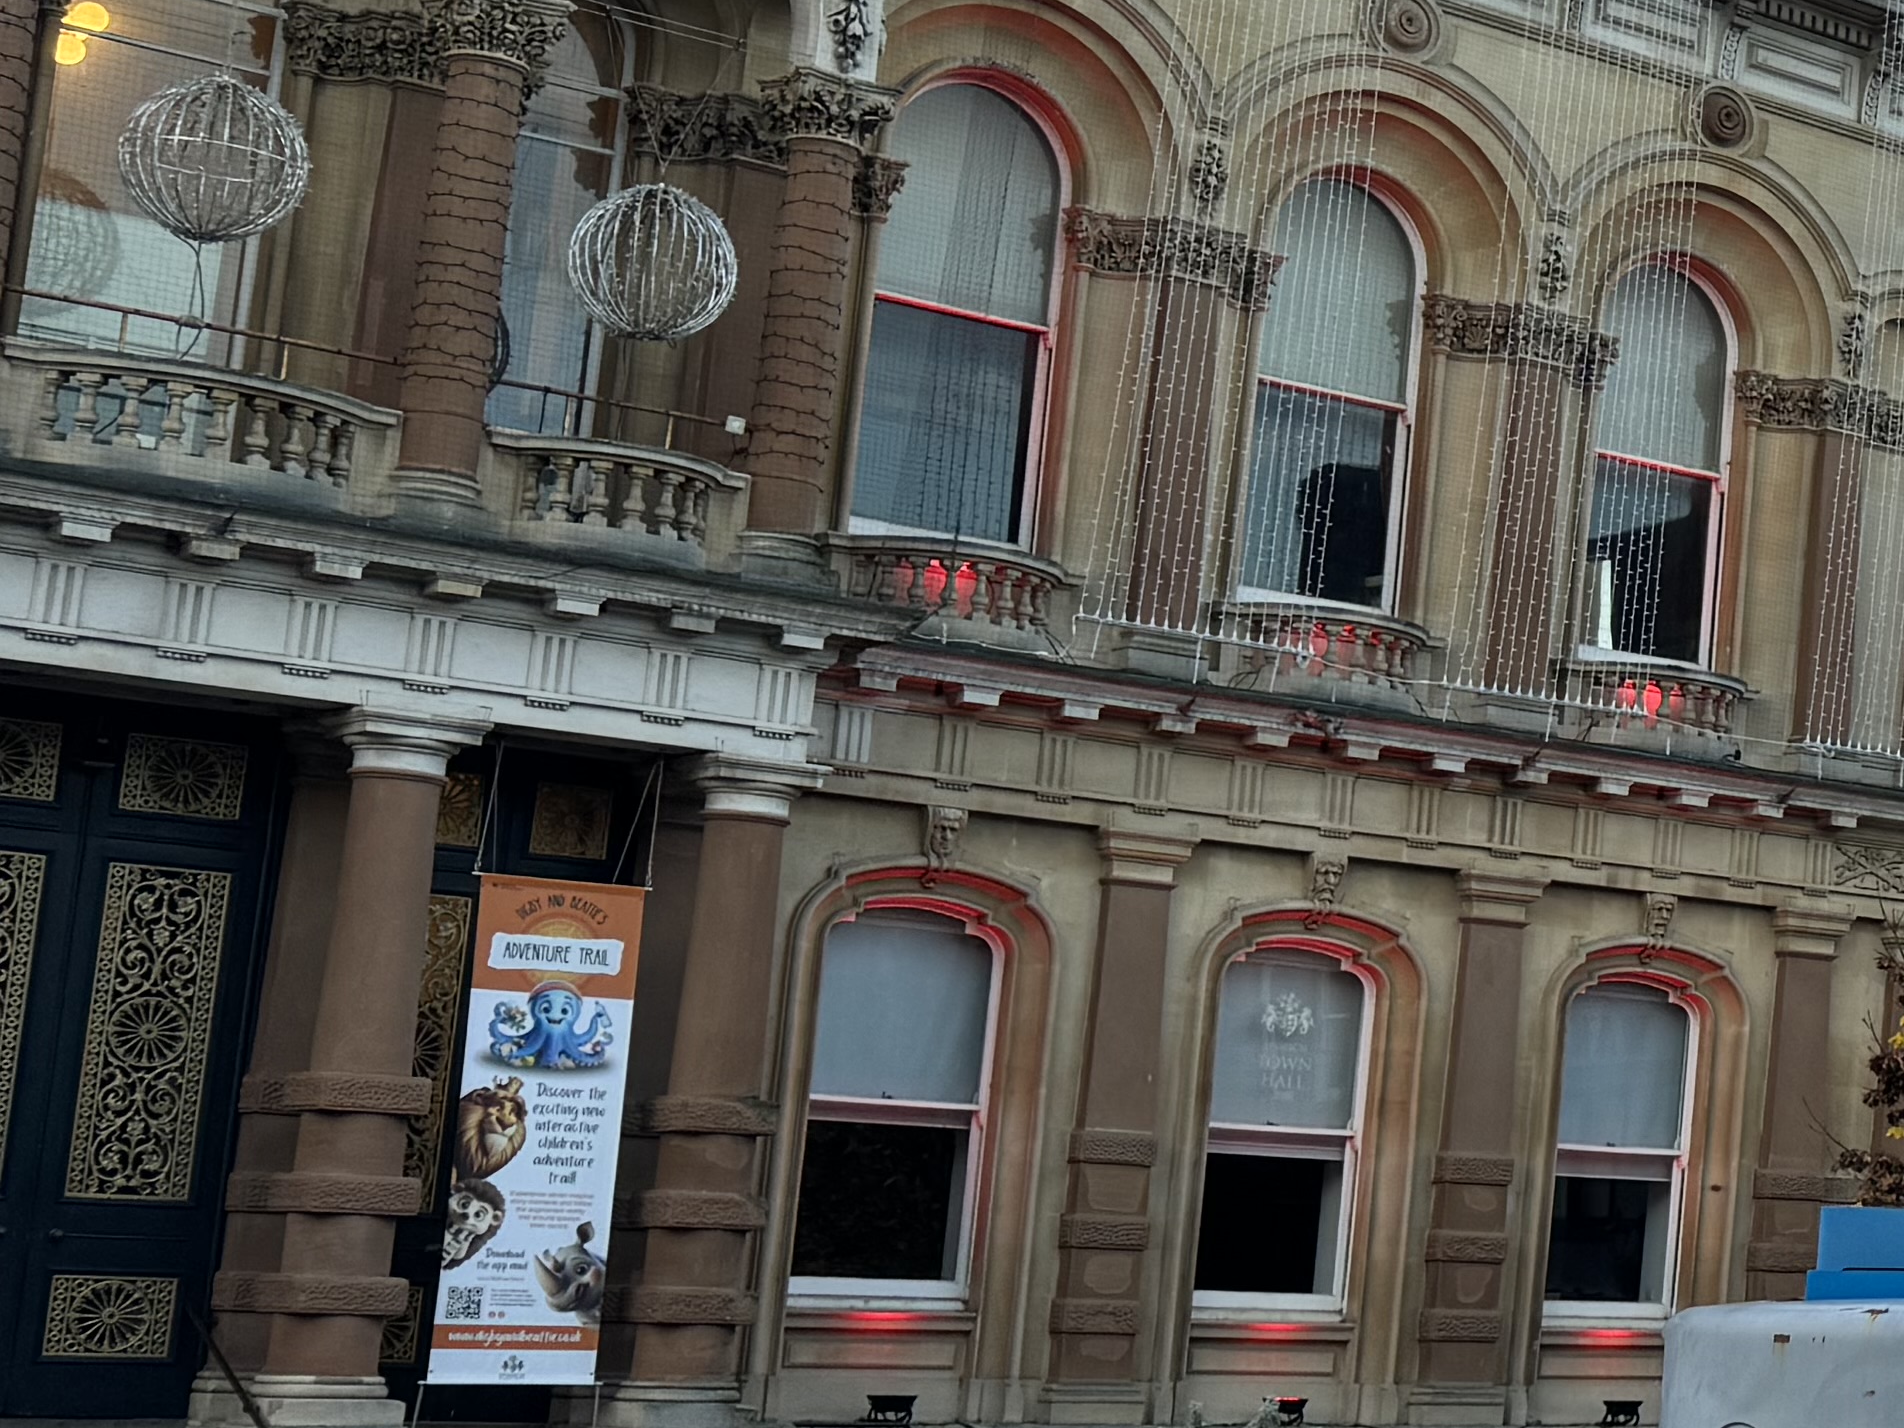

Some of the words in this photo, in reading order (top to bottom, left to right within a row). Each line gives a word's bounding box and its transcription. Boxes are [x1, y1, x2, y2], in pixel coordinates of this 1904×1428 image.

[503, 942, 571, 964] ADVENTURE
[579, 947, 609, 966] TRAIL
[536, 1082, 584, 1098] Discover
[589, 1087, 607, 1101] the
[532, 1103, 579, 1121] exciting
[582, 1107, 605, 1117] new
[535, 1120, 599, 1134] interactive
[533, 1154, 595, 1168] adventure
